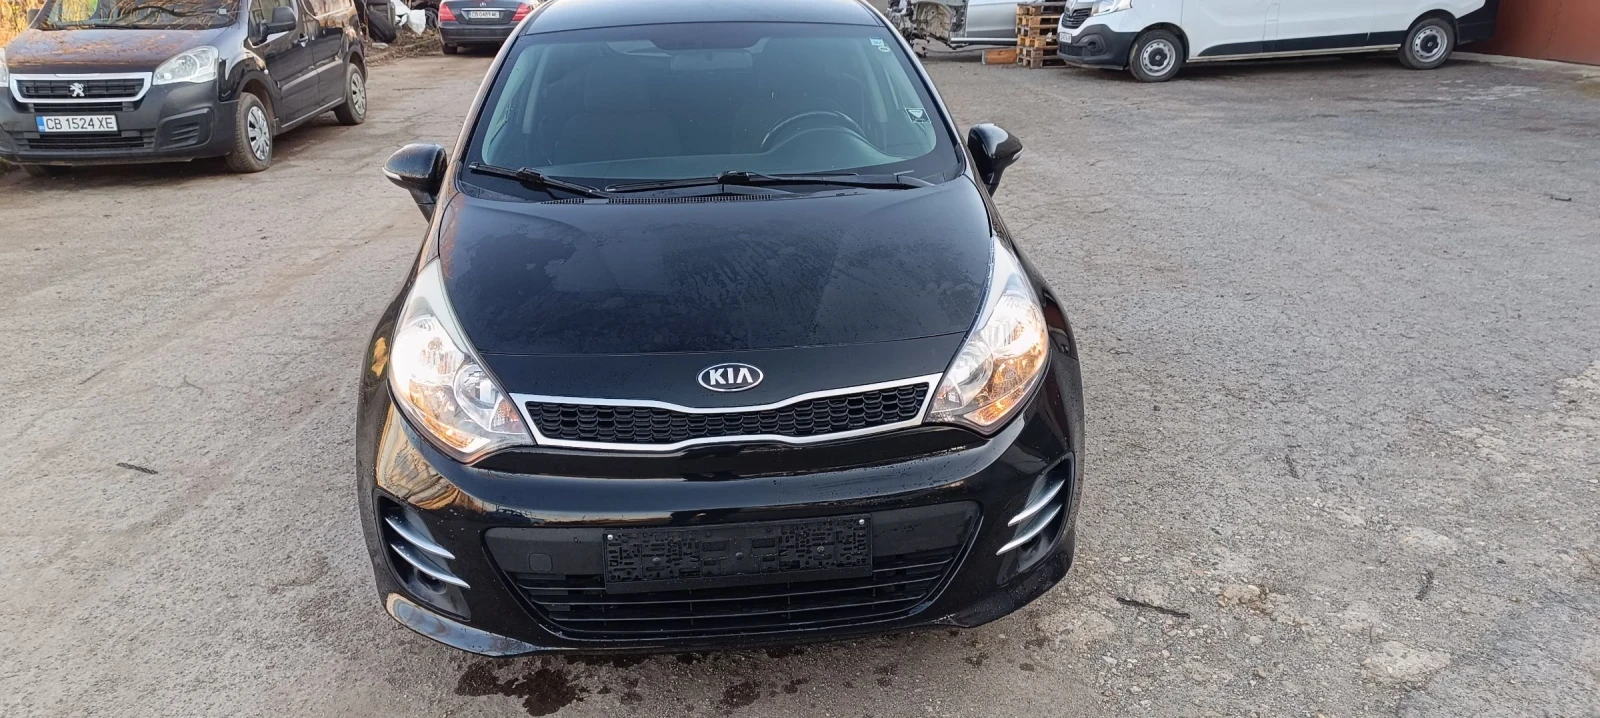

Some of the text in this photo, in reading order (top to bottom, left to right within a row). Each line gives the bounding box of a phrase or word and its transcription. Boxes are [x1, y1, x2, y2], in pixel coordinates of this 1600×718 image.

[46, 117, 114, 130] CB 1524 XE
[709, 367, 753, 385] KIA
